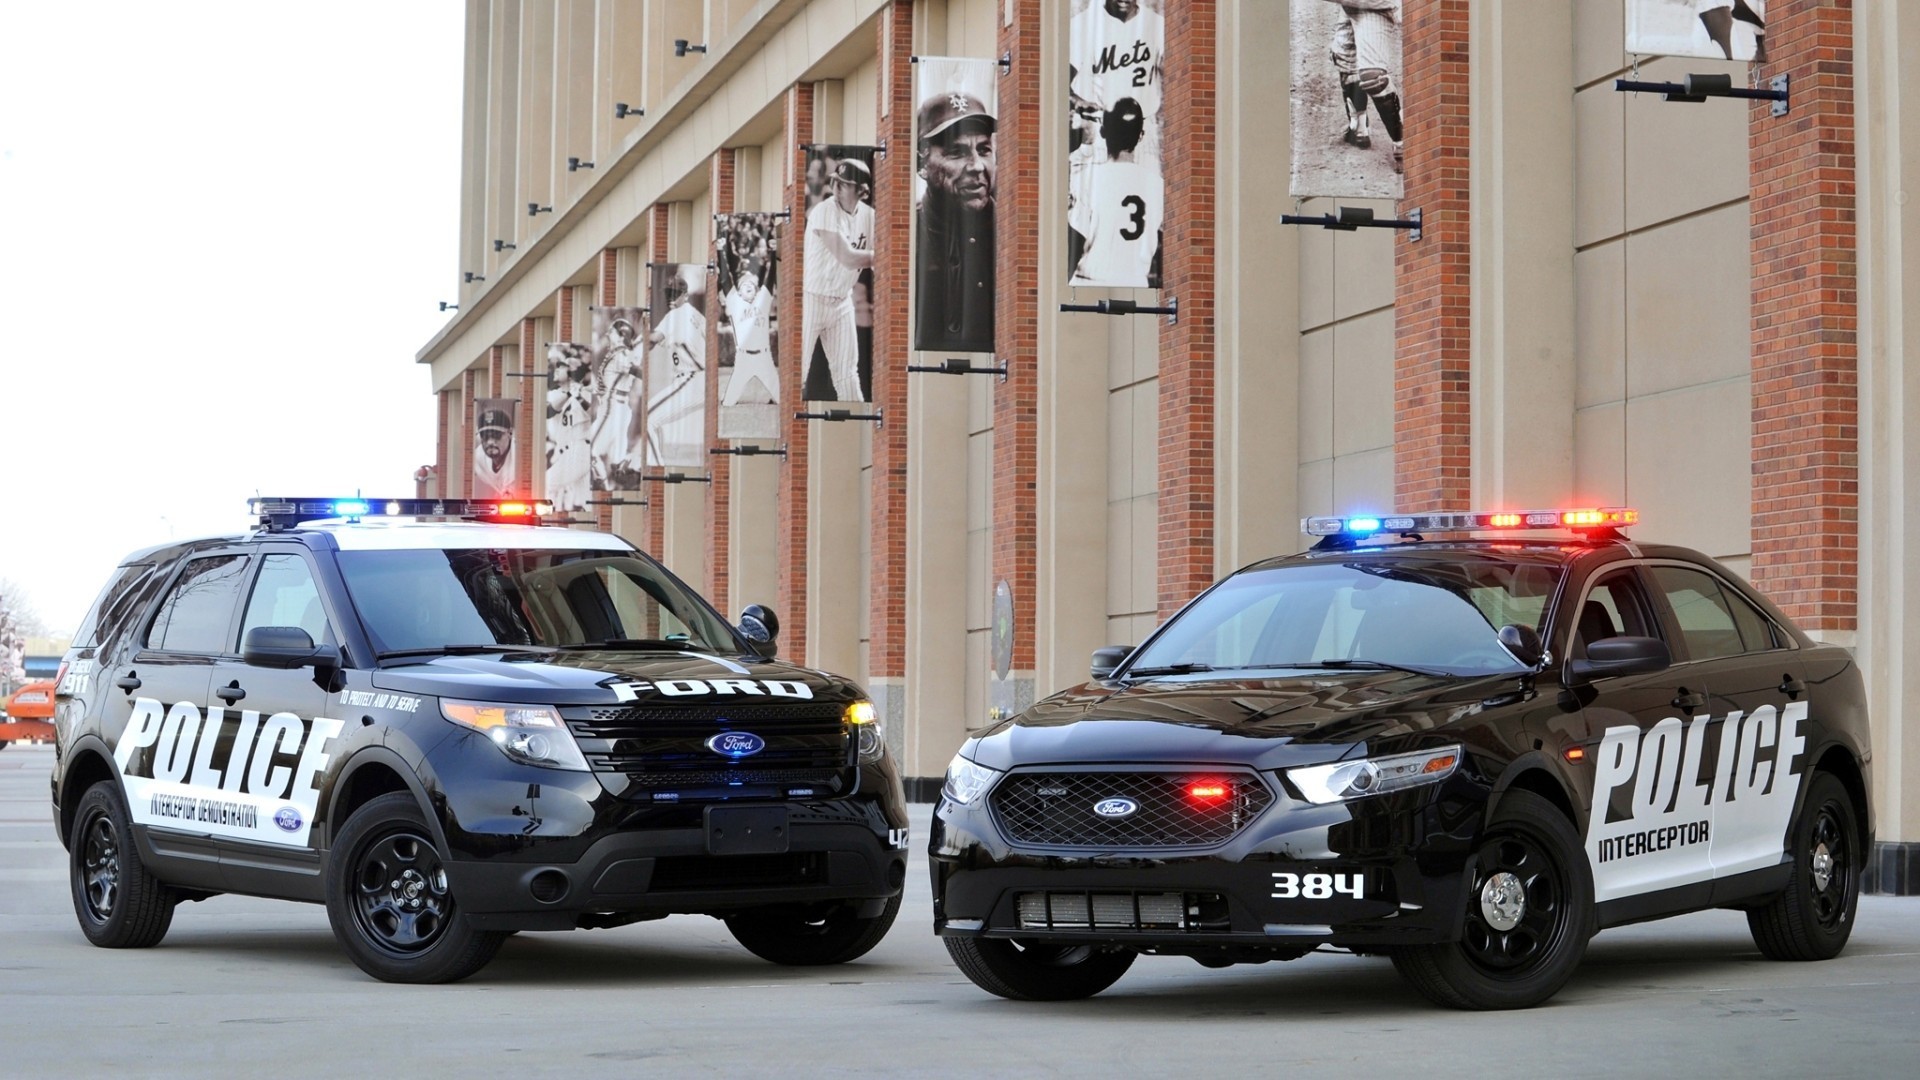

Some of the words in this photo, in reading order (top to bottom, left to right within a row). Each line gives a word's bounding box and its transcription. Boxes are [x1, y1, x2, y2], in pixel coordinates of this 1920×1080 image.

[1092, 39, 1151, 74] Mets
[1119, 194, 1146, 241] 3
[672, 352, 680, 366] 6
[64, 674, 89, 694] 911
[608, 679, 814, 702] FORD
[340, 689, 350, 705] TO
[348, 690, 376, 707] PROTECT
[372, 693, 389, 709] AND
[386, 694, 399, 710] TO
[396, 696, 421, 713] SERVE
[113, 697, 346, 804] POLICE
[722, 735, 754, 750] Ford
[1592, 700, 1808, 826] POLICE
[150, 792, 198, 820] INTERCEPTOR
[198, 798, 259, 829] DEMONSTRATION
[1102, 801, 1126, 813] Ford
[1598, 820, 1710, 864] INTERCEPTOR
[1270, 872, 1364, 900] 384
